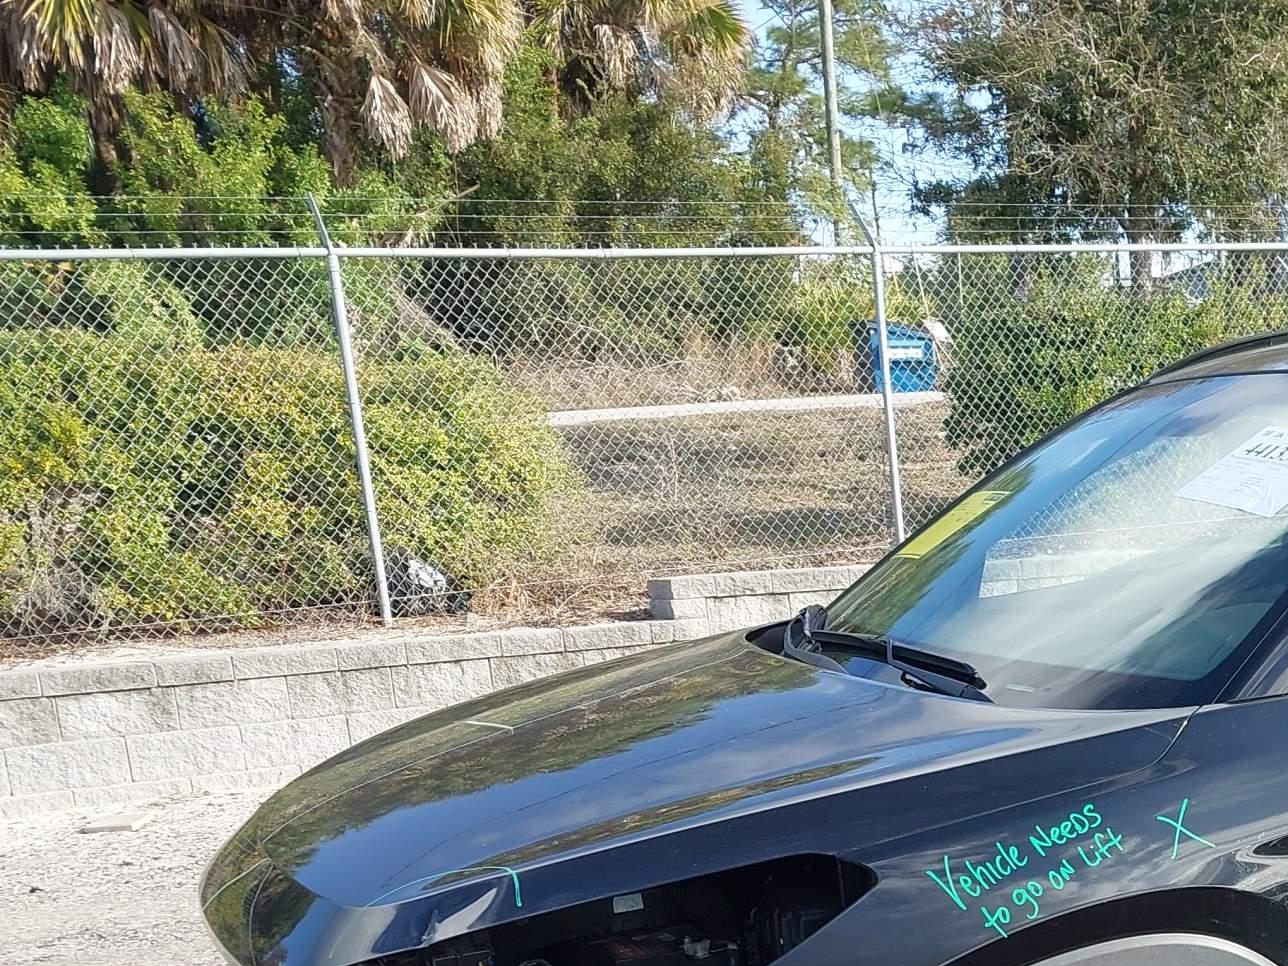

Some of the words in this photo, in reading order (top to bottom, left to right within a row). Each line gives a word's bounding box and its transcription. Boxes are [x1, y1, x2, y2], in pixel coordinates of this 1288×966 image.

[927, 842, 1029, 911] Vehicle
[983, 906, 1011, 938] to
[1010, 881, 1047, 920] go
